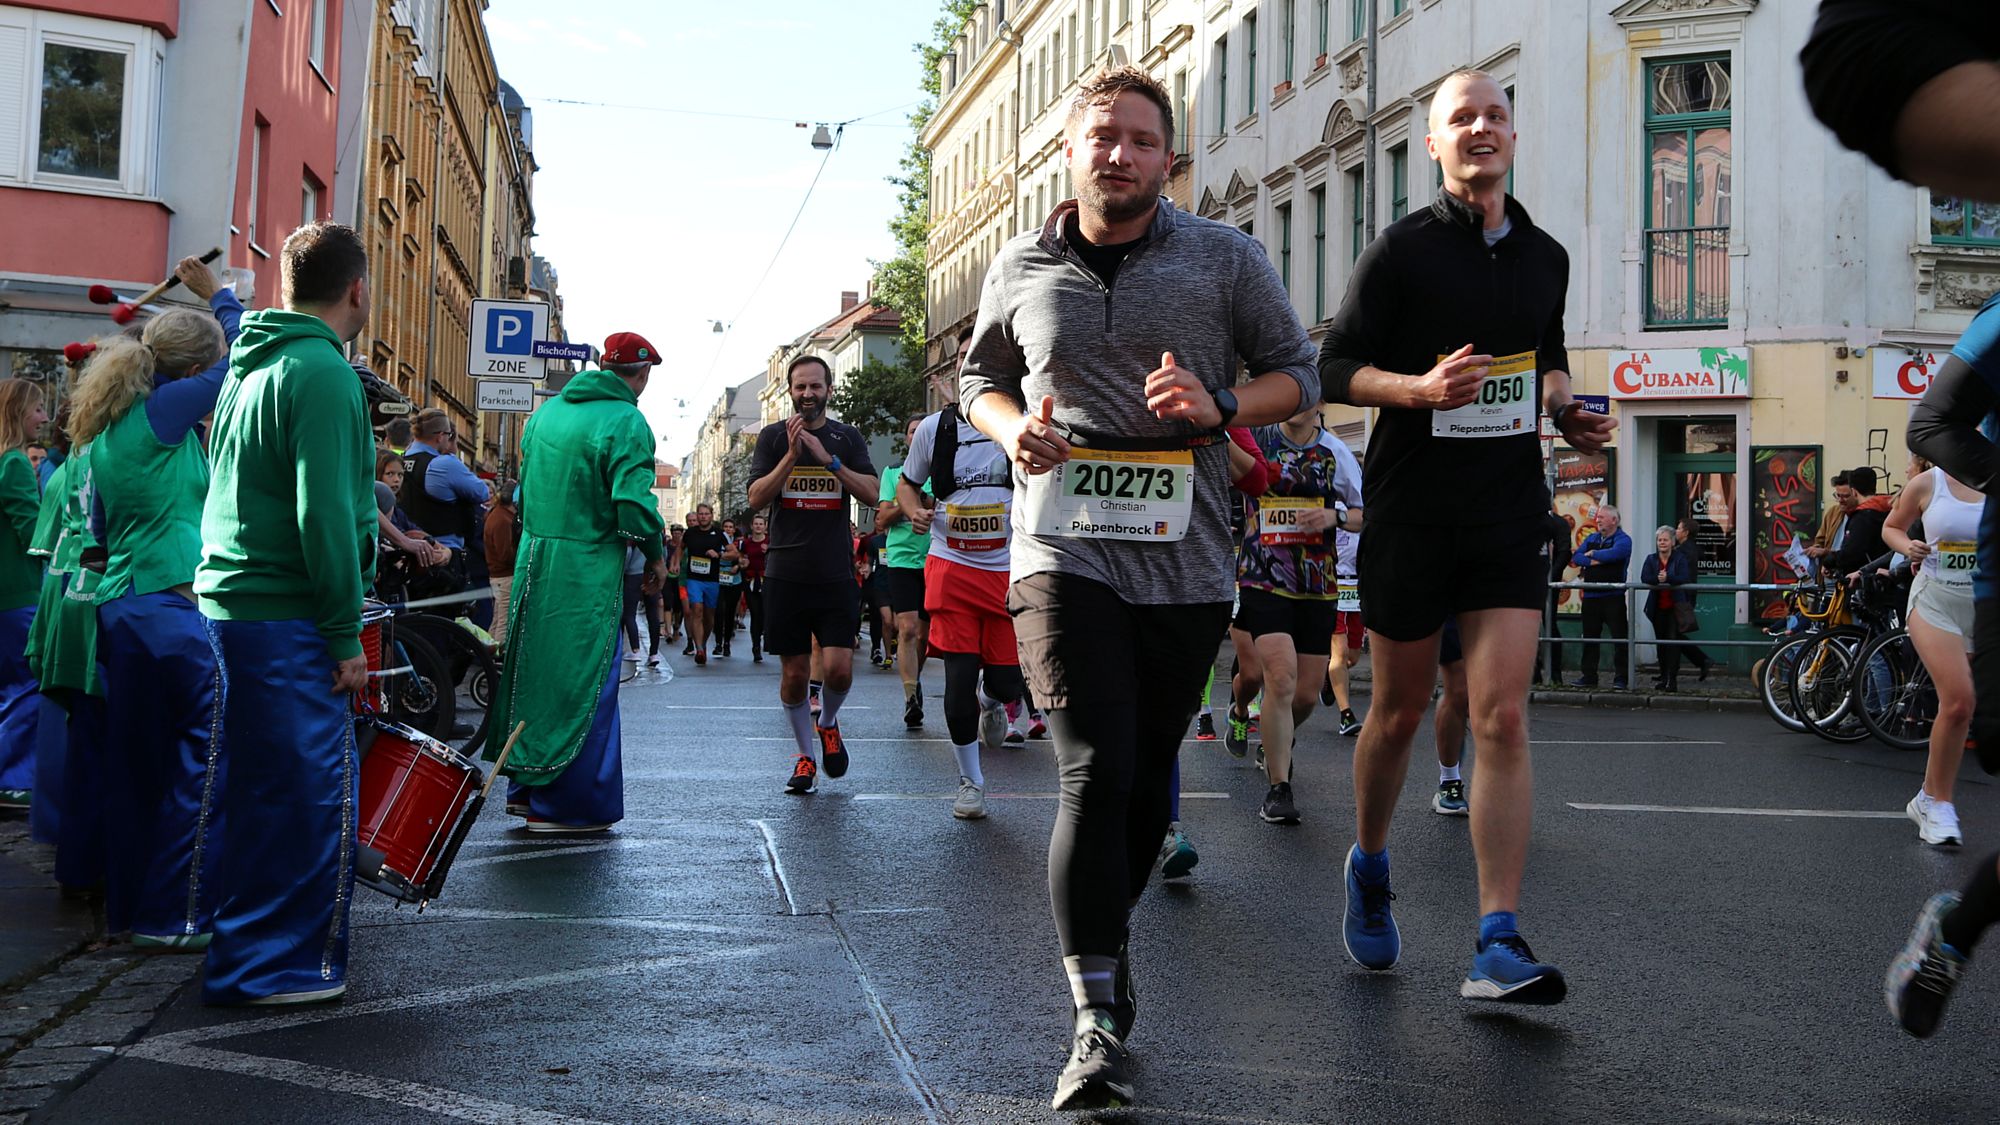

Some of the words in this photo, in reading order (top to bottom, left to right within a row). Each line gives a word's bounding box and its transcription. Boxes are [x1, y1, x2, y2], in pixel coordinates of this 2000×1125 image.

[497, 315, 522, 348] P
[537, 344, 586, 358] Bischofsweg
[1630, 353, 1652, 364] LA
[487, 360, 527, 373] ZONE
[1613, 361, 1715, 394] CUBANA
[499, 388, 513, 396] mit
[1474, 376, 1523, 405] 050
[1700, 387, 1716, 395] Bar
[481, 396, 529, 406] Parkschein
[1480, 407, 1503, 415] Kevin
[1450, 423, 1511, 434] Piepenbrock
[1558, 461, 1605, 479] TAPAS
[790, 479, 835, 492] 40890
[1074, 464, 1174, 500] 20273
[1100, 501, 1146, 512] Christian
[951, 516, 999, 532] 40500
[1269, 510, 1298, 525] 405
[1072, 521, 1152, 536] Piepenbrock
[1772, 475, 1799, 584] TAPAS
[1947, 554, 1976, 569] 209
